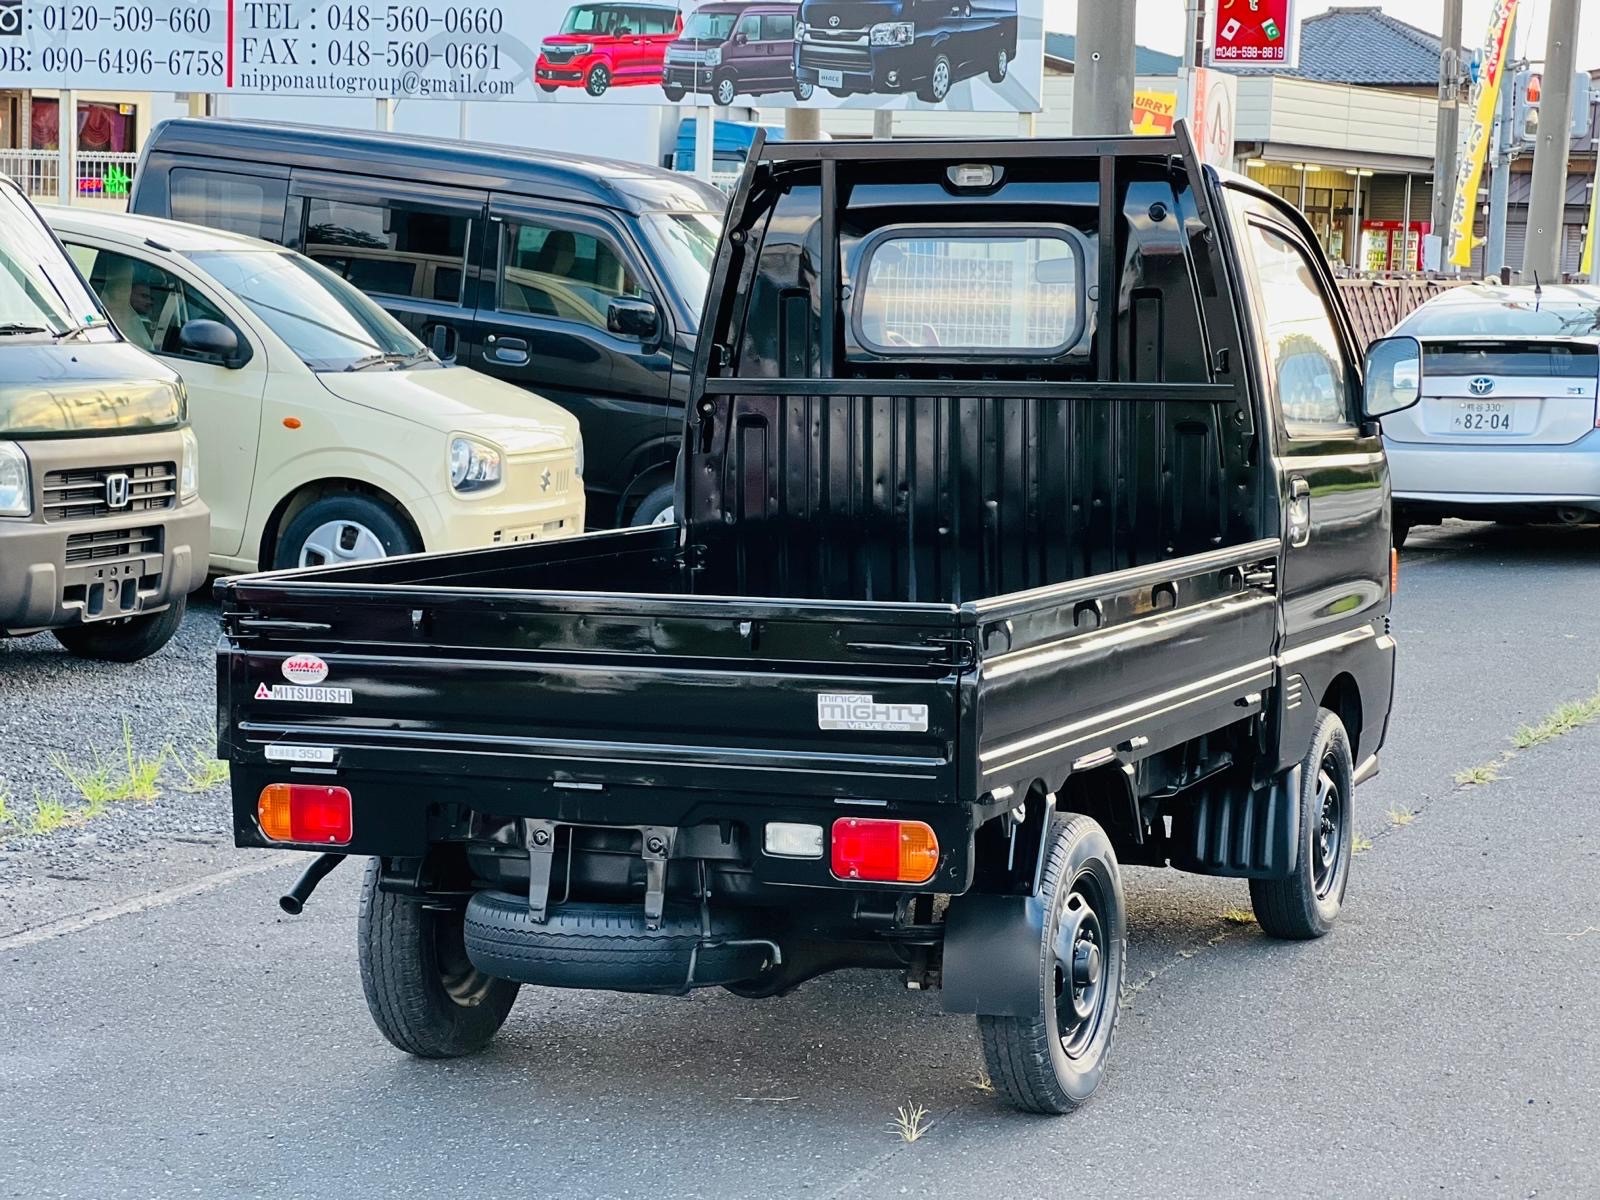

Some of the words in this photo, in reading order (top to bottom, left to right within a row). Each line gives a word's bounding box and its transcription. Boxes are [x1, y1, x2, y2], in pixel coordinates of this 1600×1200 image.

[43, 5, 211, 33] 0120-509-660
[327, 4, 504, 34] 048-560-0660
[42, 47, 224, 77] 090-6496-6758
[327, 39, 502, 70] 048-560-0661
[240, 68, 515, 95] nipponautogroup@gmail.com
[1135, 96, 1173, 114] URRY
[1485, 403, 1501, 411] 330
[1464, 413, 1510, 430] 82-04
[287, 661, 323, 670] SHAZA
[273, 686, 352, 703] MITSUBISHI
